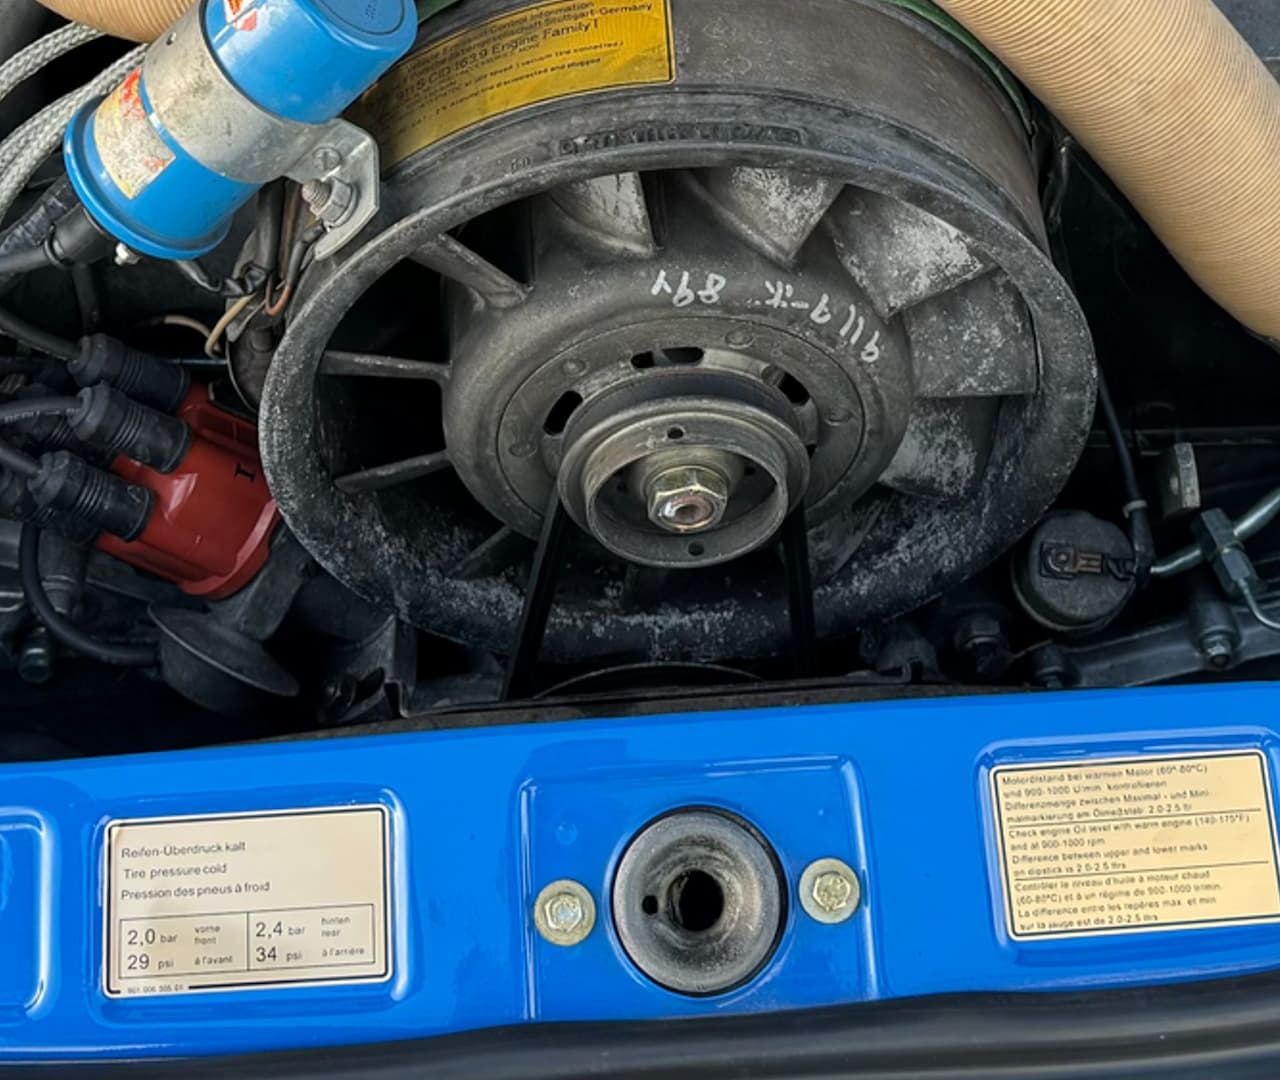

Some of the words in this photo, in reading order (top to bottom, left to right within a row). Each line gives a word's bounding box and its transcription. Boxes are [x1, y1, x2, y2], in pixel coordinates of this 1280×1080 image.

[491, 32, 539, 56] Engine
[542, 22, 591, 41] Family
[1066, 772, 1082, 781] bei
[1083, 769, 1123, 780] warmen
[1124, 766, 1153, 777] Motor
[1106, 779, 1168, 791] kontrollieren
[1078, 794, 1121, 806] zwischen
[1122, 791, 1161, 803] Maximal
[1169, 790, 1188, 800] und
[1075, 810, 1091, 819] am
[1007, 828, 1037, 839] Check
[1039, 826, 1071, 837] engine
[1072, 824, 1086, 834] Oil
[1088, 823, 1111, 833] level
[1113, 821, 1131, 831] with
[1134, 820, 1159, 830] warm
[1161, 818, 1192, 829] engine
[121, 843, 223, 859] Reifen-Überdruck
[225, 841, 246, 853] kalt
[1009, 841, 1028, 851] and
[1029, 841, 1040, 849] at
[1086, 837, 1105, 847] rpm
[1011, 852, 1060, 865] Difference
[1061, 850, 1101, 861] between
[1103, 848, 1130, 859] upper
[1131, 846, 1150, 856] and
[1152, 844, 1177, 854] lower
[1178, 842, 1208, 852] marks
[123, 869, 146, 879] Tire
[150, 866, 201, 879] pressure
[203, 863, 227, 875] cold
[1013, 868, 1026, 877] on
[1027, 865, 1063, 876] dipstick
[1059, 880, 1069, 888] le
[1071, 878, 1102, 888] niveau
[1104, 875, 1136, 885] d'huile
[1146, 872, 1179, 882] moteur
[1181, 870, 1210, 879] chaud
[121, 888, 172, 900] Pression
[174, 886, 195, 897] des
[197, 885, 233, 897] pneus
[235, 882, 242, 894] à
[244, 881, 270, 893] froid
[1063, 893, 1073, 901] et
[1084, 892, 1096, 900] un
[1132, 887, 1145, 896] de
[1017, 909, 1029, 918] La
[1080, 903, 1105, 913] entre
[1107, 902, 1122, 911] les
[1186, 897, 1196, 905] et
[1019, 922, 1035, 931] sur
[1075, 917, 1090, 926] est
[1092, 915, 1105, 925] de
[127, 929, 156, 946] 2,0
[160, 933, 177, 943] bar
[255, 922, 283, 938] 2,4
[288, 925, 305, 936] bar
[127, 954, 150, 970] 29
[158, 958, 174, 970] psi
[255, 946, 277, 962] 34
[286, 950, 302, 962] psi
